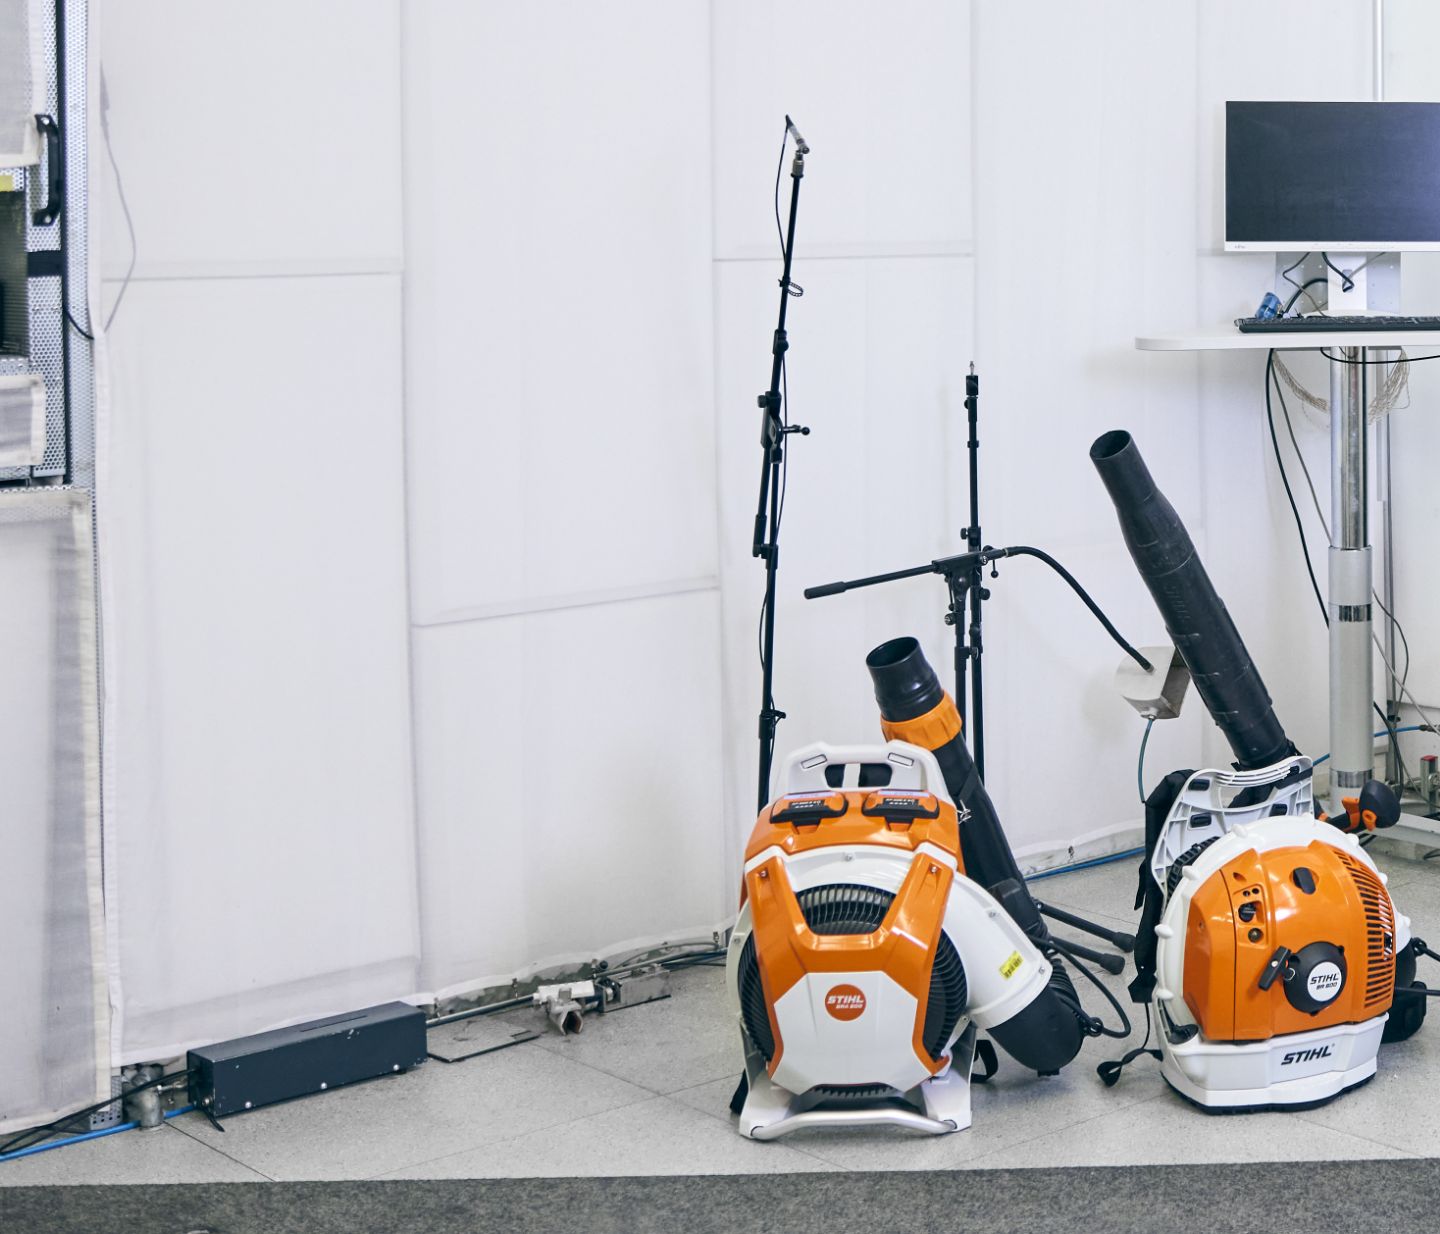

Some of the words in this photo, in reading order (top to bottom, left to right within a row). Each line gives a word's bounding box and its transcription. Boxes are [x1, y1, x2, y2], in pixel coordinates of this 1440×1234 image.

[1309, 973, 1339, 985] STIHL
[827, 995, 864, 1005] STIHL
[1280, 1044, 1332, 1066] STIHL
